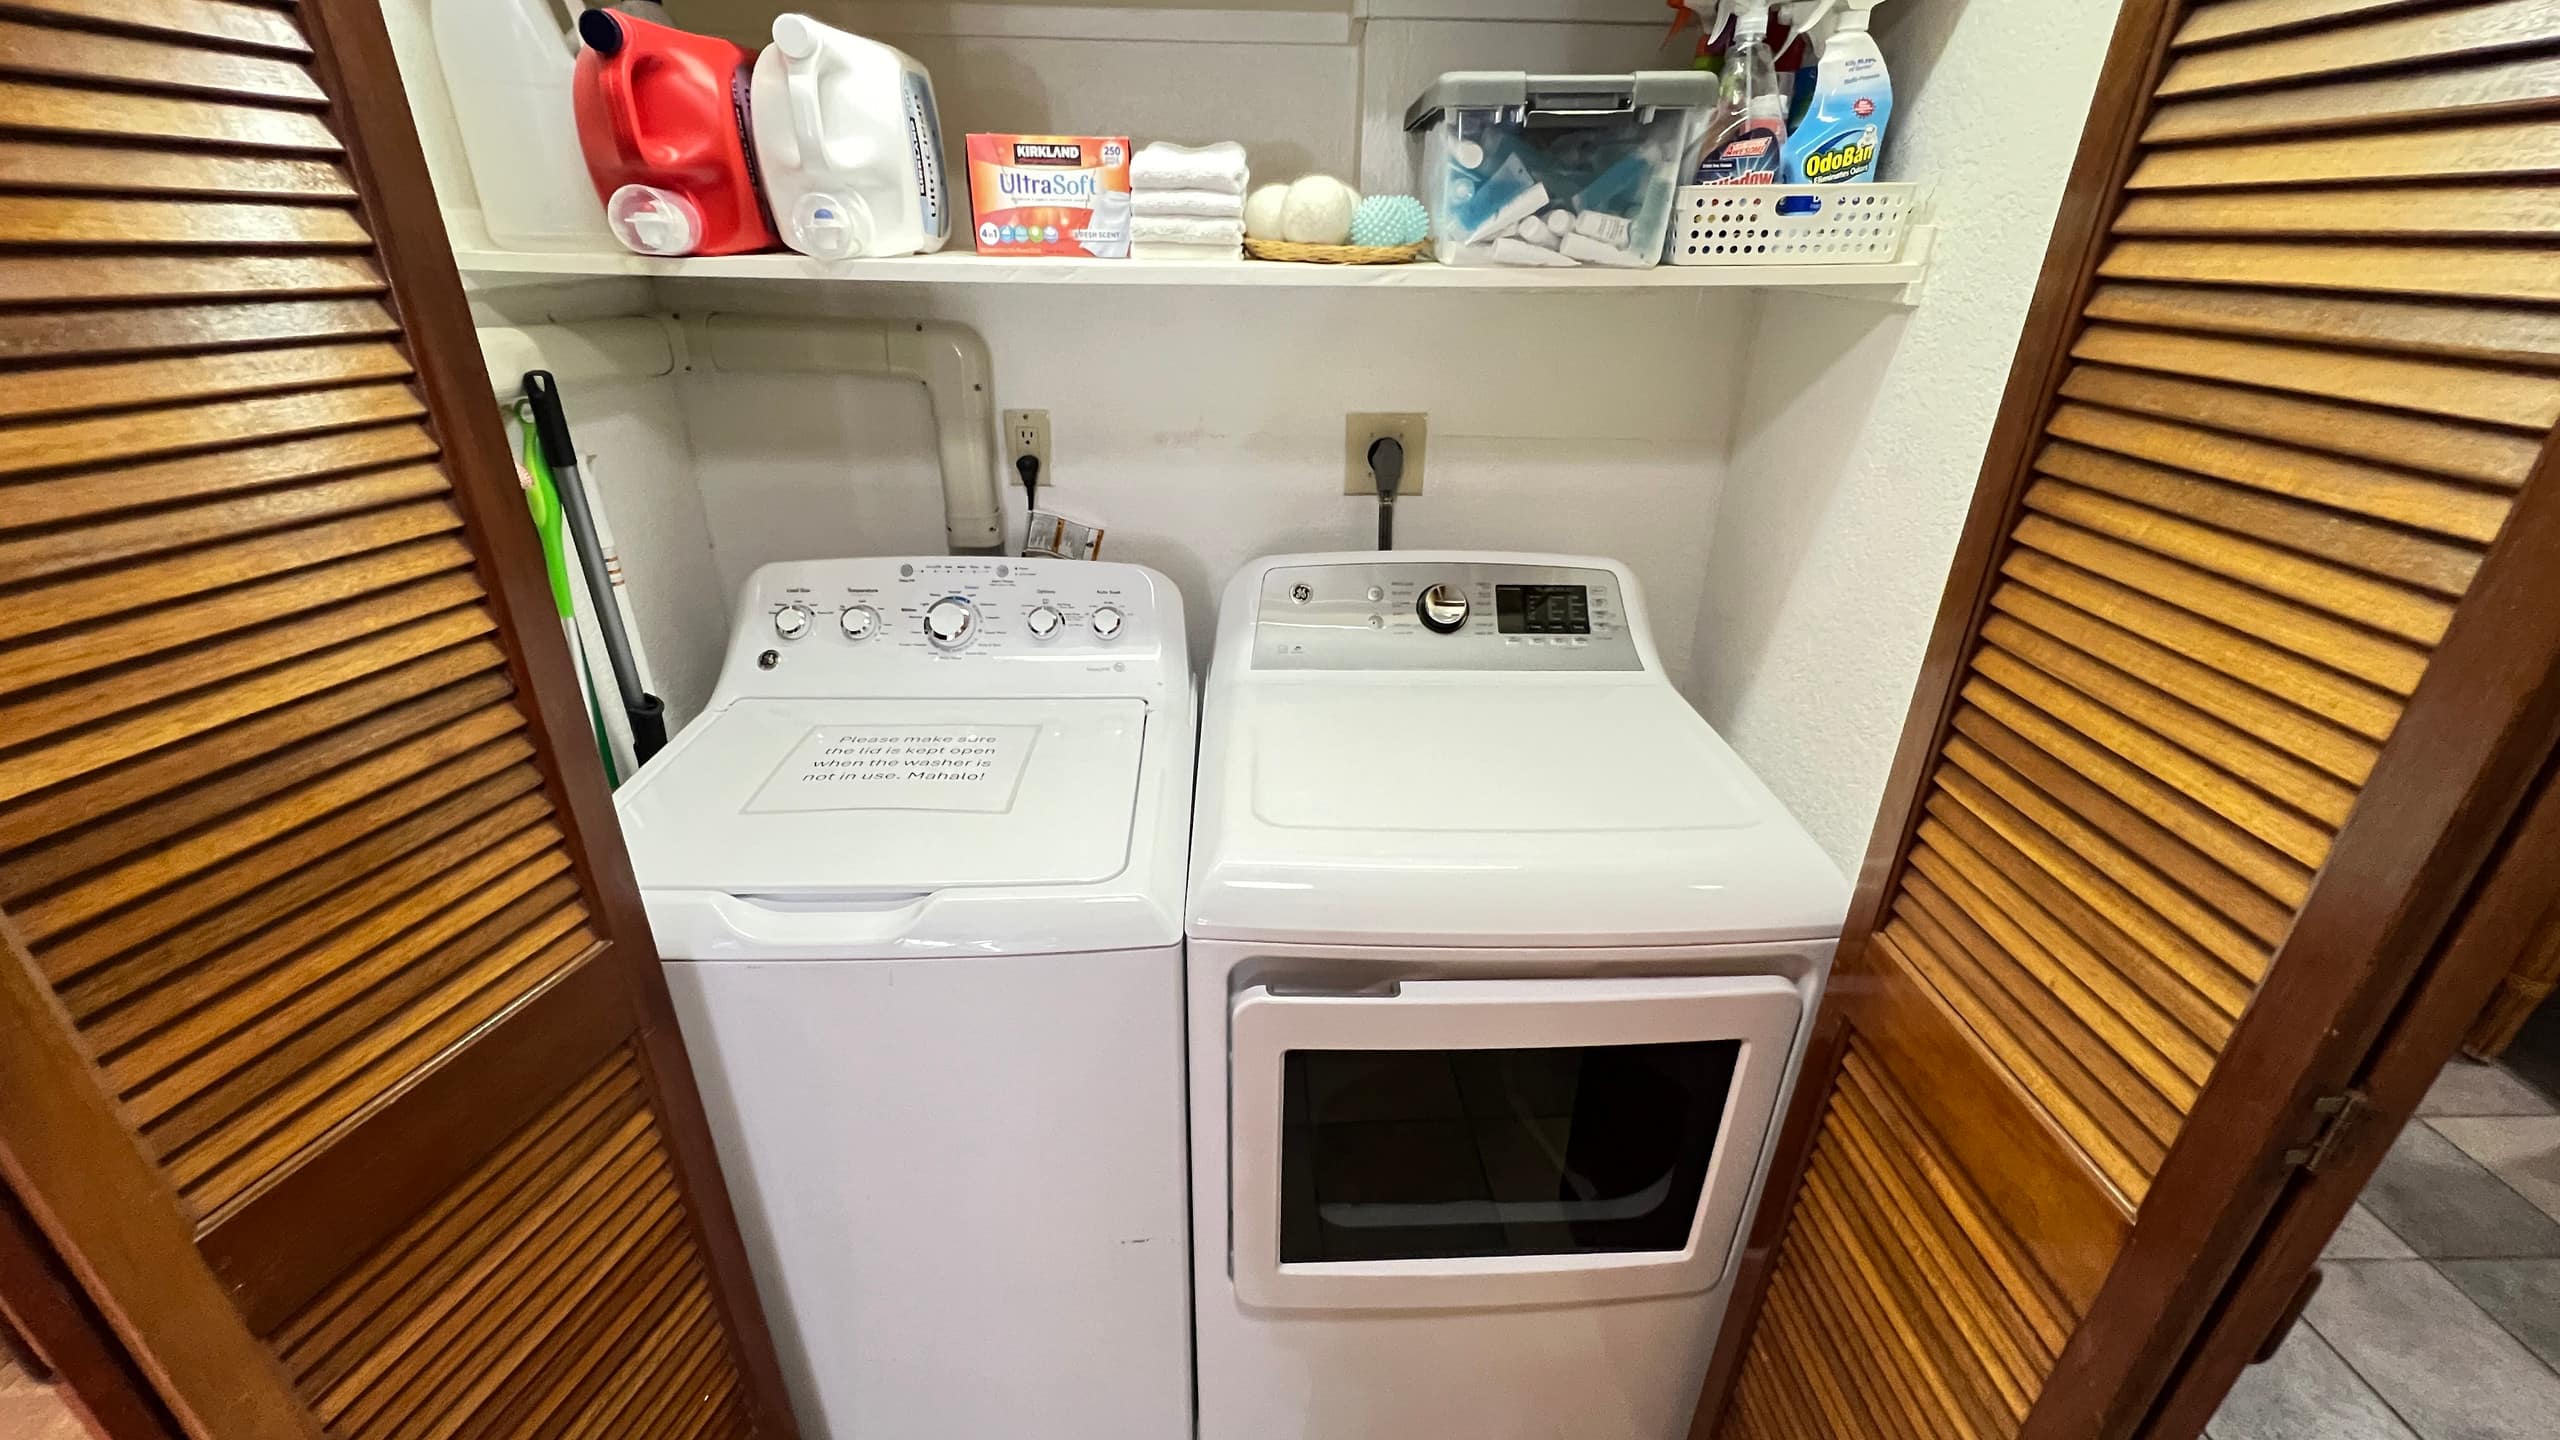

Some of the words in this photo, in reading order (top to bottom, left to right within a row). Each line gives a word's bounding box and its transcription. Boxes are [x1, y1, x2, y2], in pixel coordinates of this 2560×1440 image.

[1016, 144, 1080, 159] KIRKLAND
[1103, 146, 1121, 156] 250
[1805, 145, 1874, 178] OdoBan
[999, 173, 1097, 195] UltraSoft
[839, 735, 901, 744] Please
[903, 735, 953, 744] make
[957, 736, 997, 744] sure
[825, 747, 855, 755] the
[859, 747, 882, 755] lid
[885, 747, 901, 755] is
[905, 747, 945, 756] kept
[949, 747, 996, 756] open
[813, 759, 864, 768] when
[869, 759, 899, 767] the
[904, 759, 973, 768] washer
[976, 760, 992, 768] is
[801, 773, 835, 782] not
[839, 773, 857, 781] in
[861, 772, 901, 781] use.
[907, 771, 985, 781] Mahalo!
